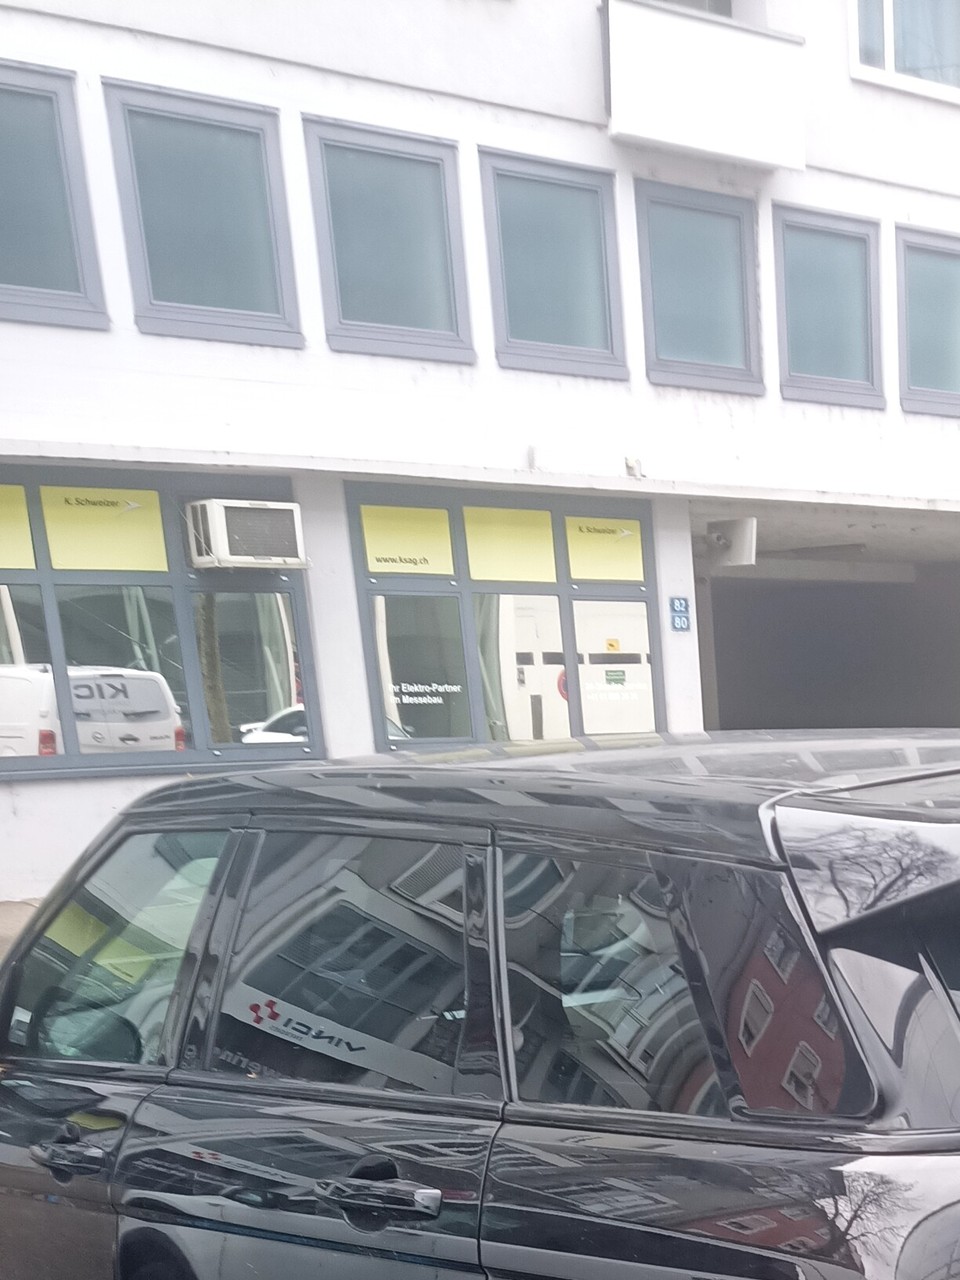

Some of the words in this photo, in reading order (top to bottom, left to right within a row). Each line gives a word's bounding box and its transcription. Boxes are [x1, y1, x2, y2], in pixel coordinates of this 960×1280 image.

[375, 555, 430, 566] www.ksag.ch
[673, 598, 686, 611] 82
[674, 615, 688, 629] 80
[400, 682, 463, 693] Elektro-Partner
[401, 694, 444, 704] Messebau
